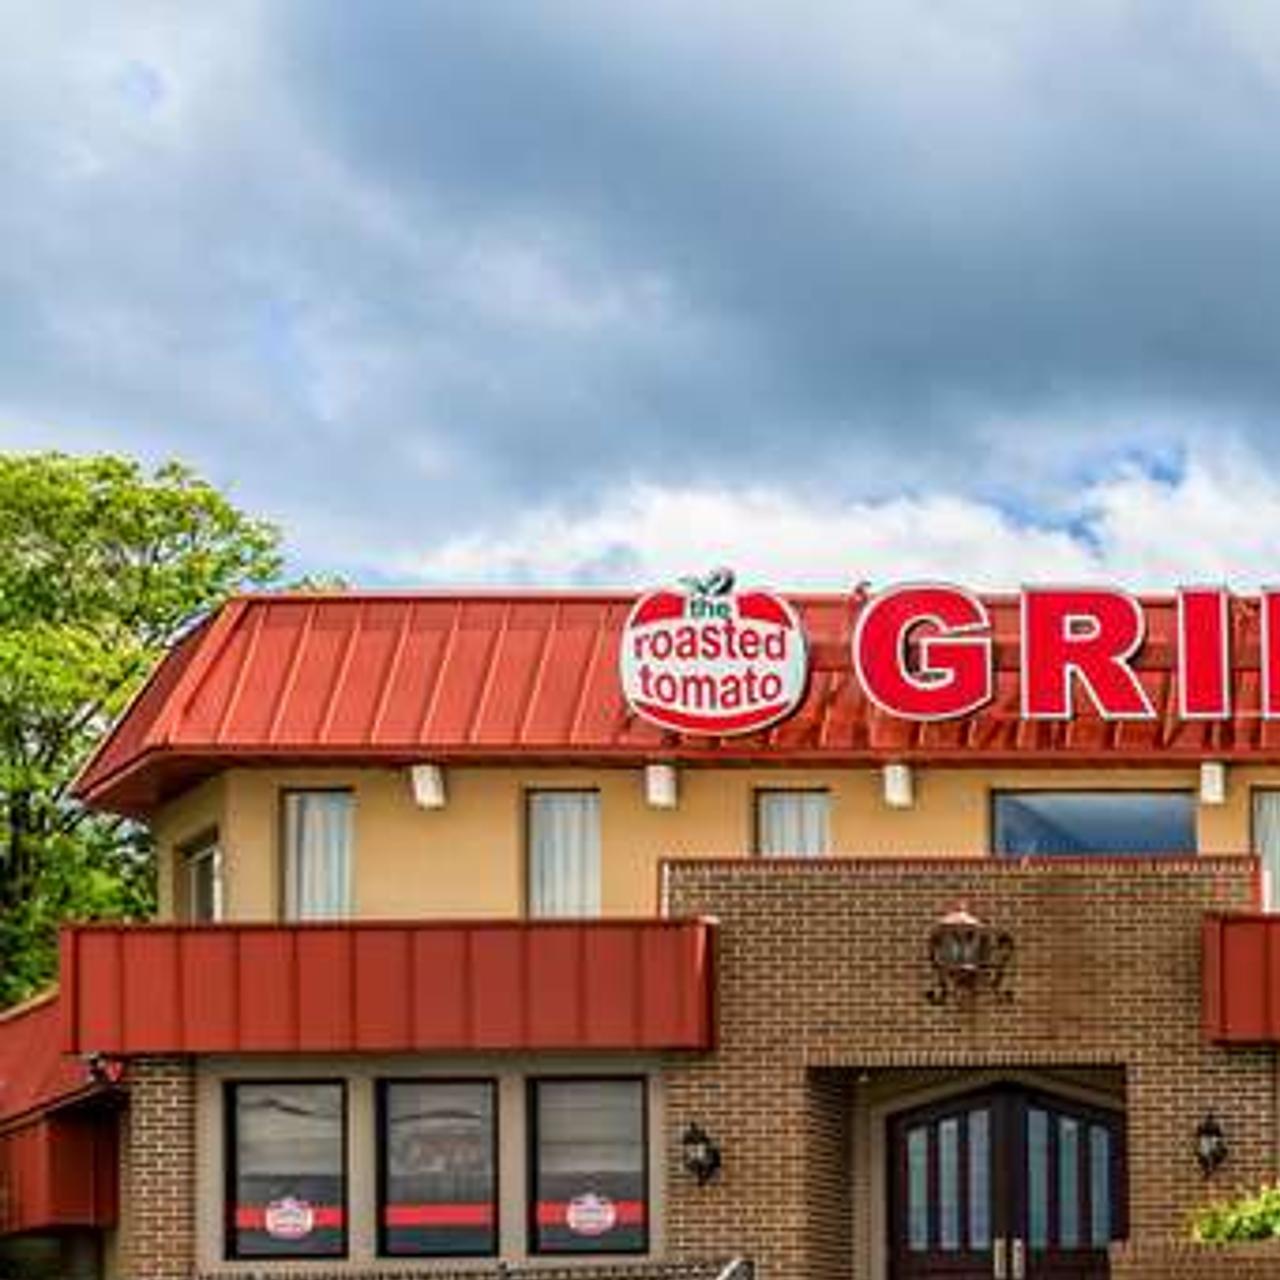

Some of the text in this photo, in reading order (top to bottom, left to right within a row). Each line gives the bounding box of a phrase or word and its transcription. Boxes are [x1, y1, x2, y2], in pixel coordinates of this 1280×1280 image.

[690, 595, 730, 618] the
[634, 619, 786, 660] roasted
[638, 666, 782, 708] tomato
